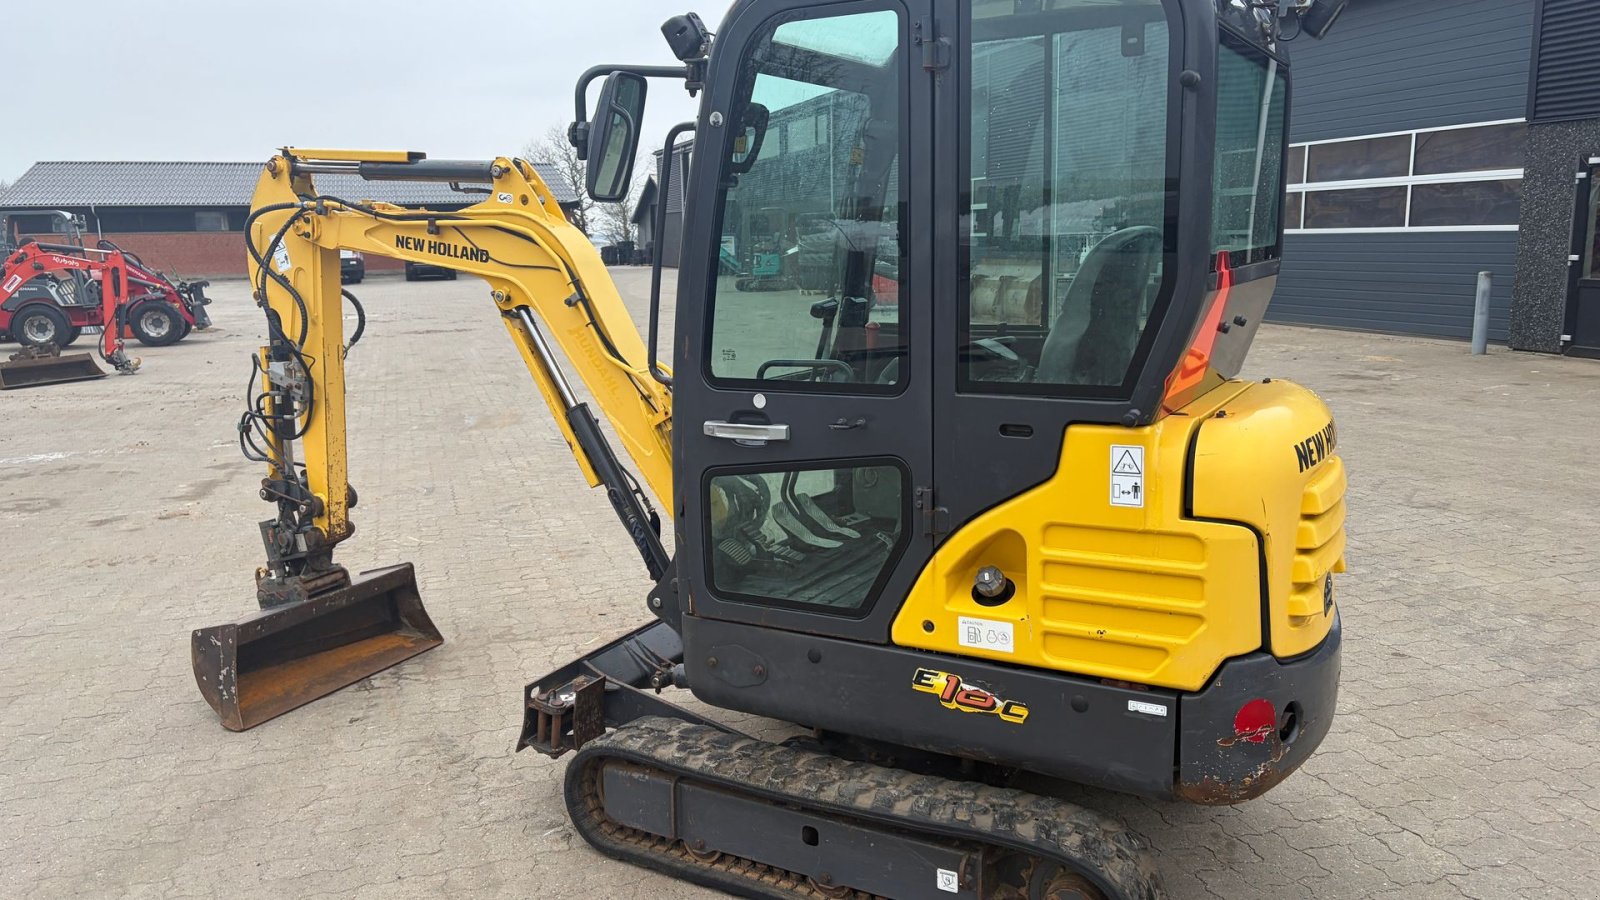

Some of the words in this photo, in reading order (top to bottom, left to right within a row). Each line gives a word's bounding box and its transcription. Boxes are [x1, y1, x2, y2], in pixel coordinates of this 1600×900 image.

[395, 235, 425, 252] NEW
[428, 240, 490, 263] HOLLAND
[1294, 431, 1325, 474] NEW
